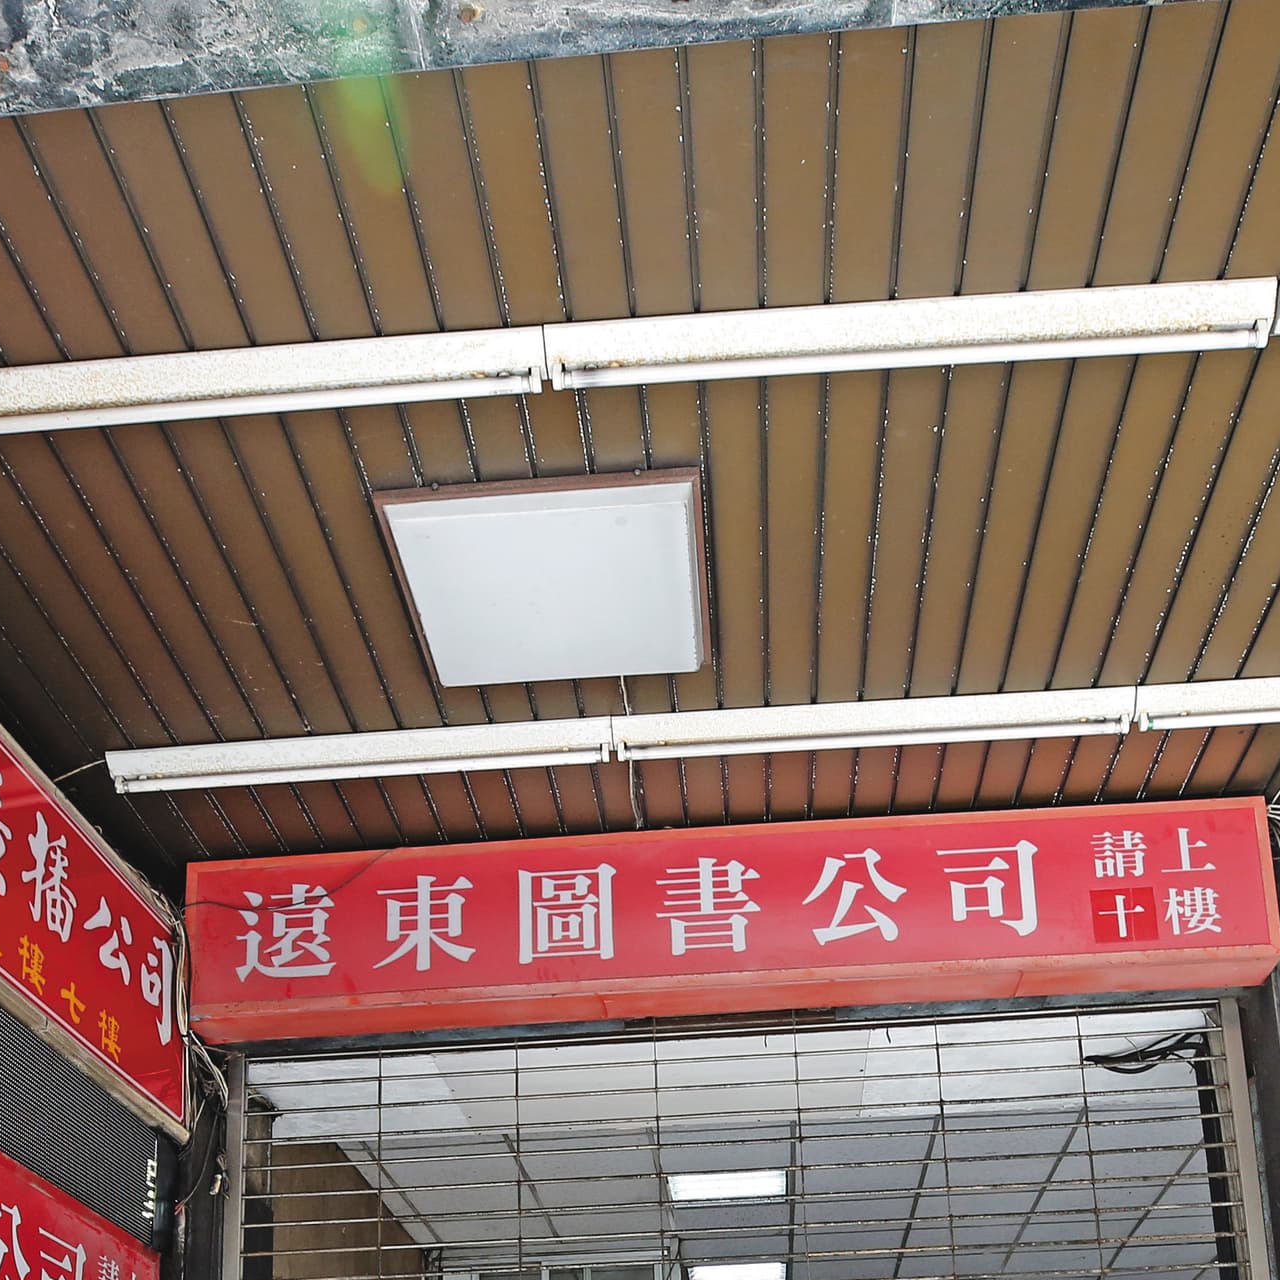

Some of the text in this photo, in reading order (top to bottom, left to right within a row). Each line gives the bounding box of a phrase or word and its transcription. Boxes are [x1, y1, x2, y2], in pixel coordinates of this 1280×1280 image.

[1093, 827, 1217, 880] 請上
[235, 838, 1039, 984] 遠東圖書公司
[1097, 885, 1222, 941] 十樓
